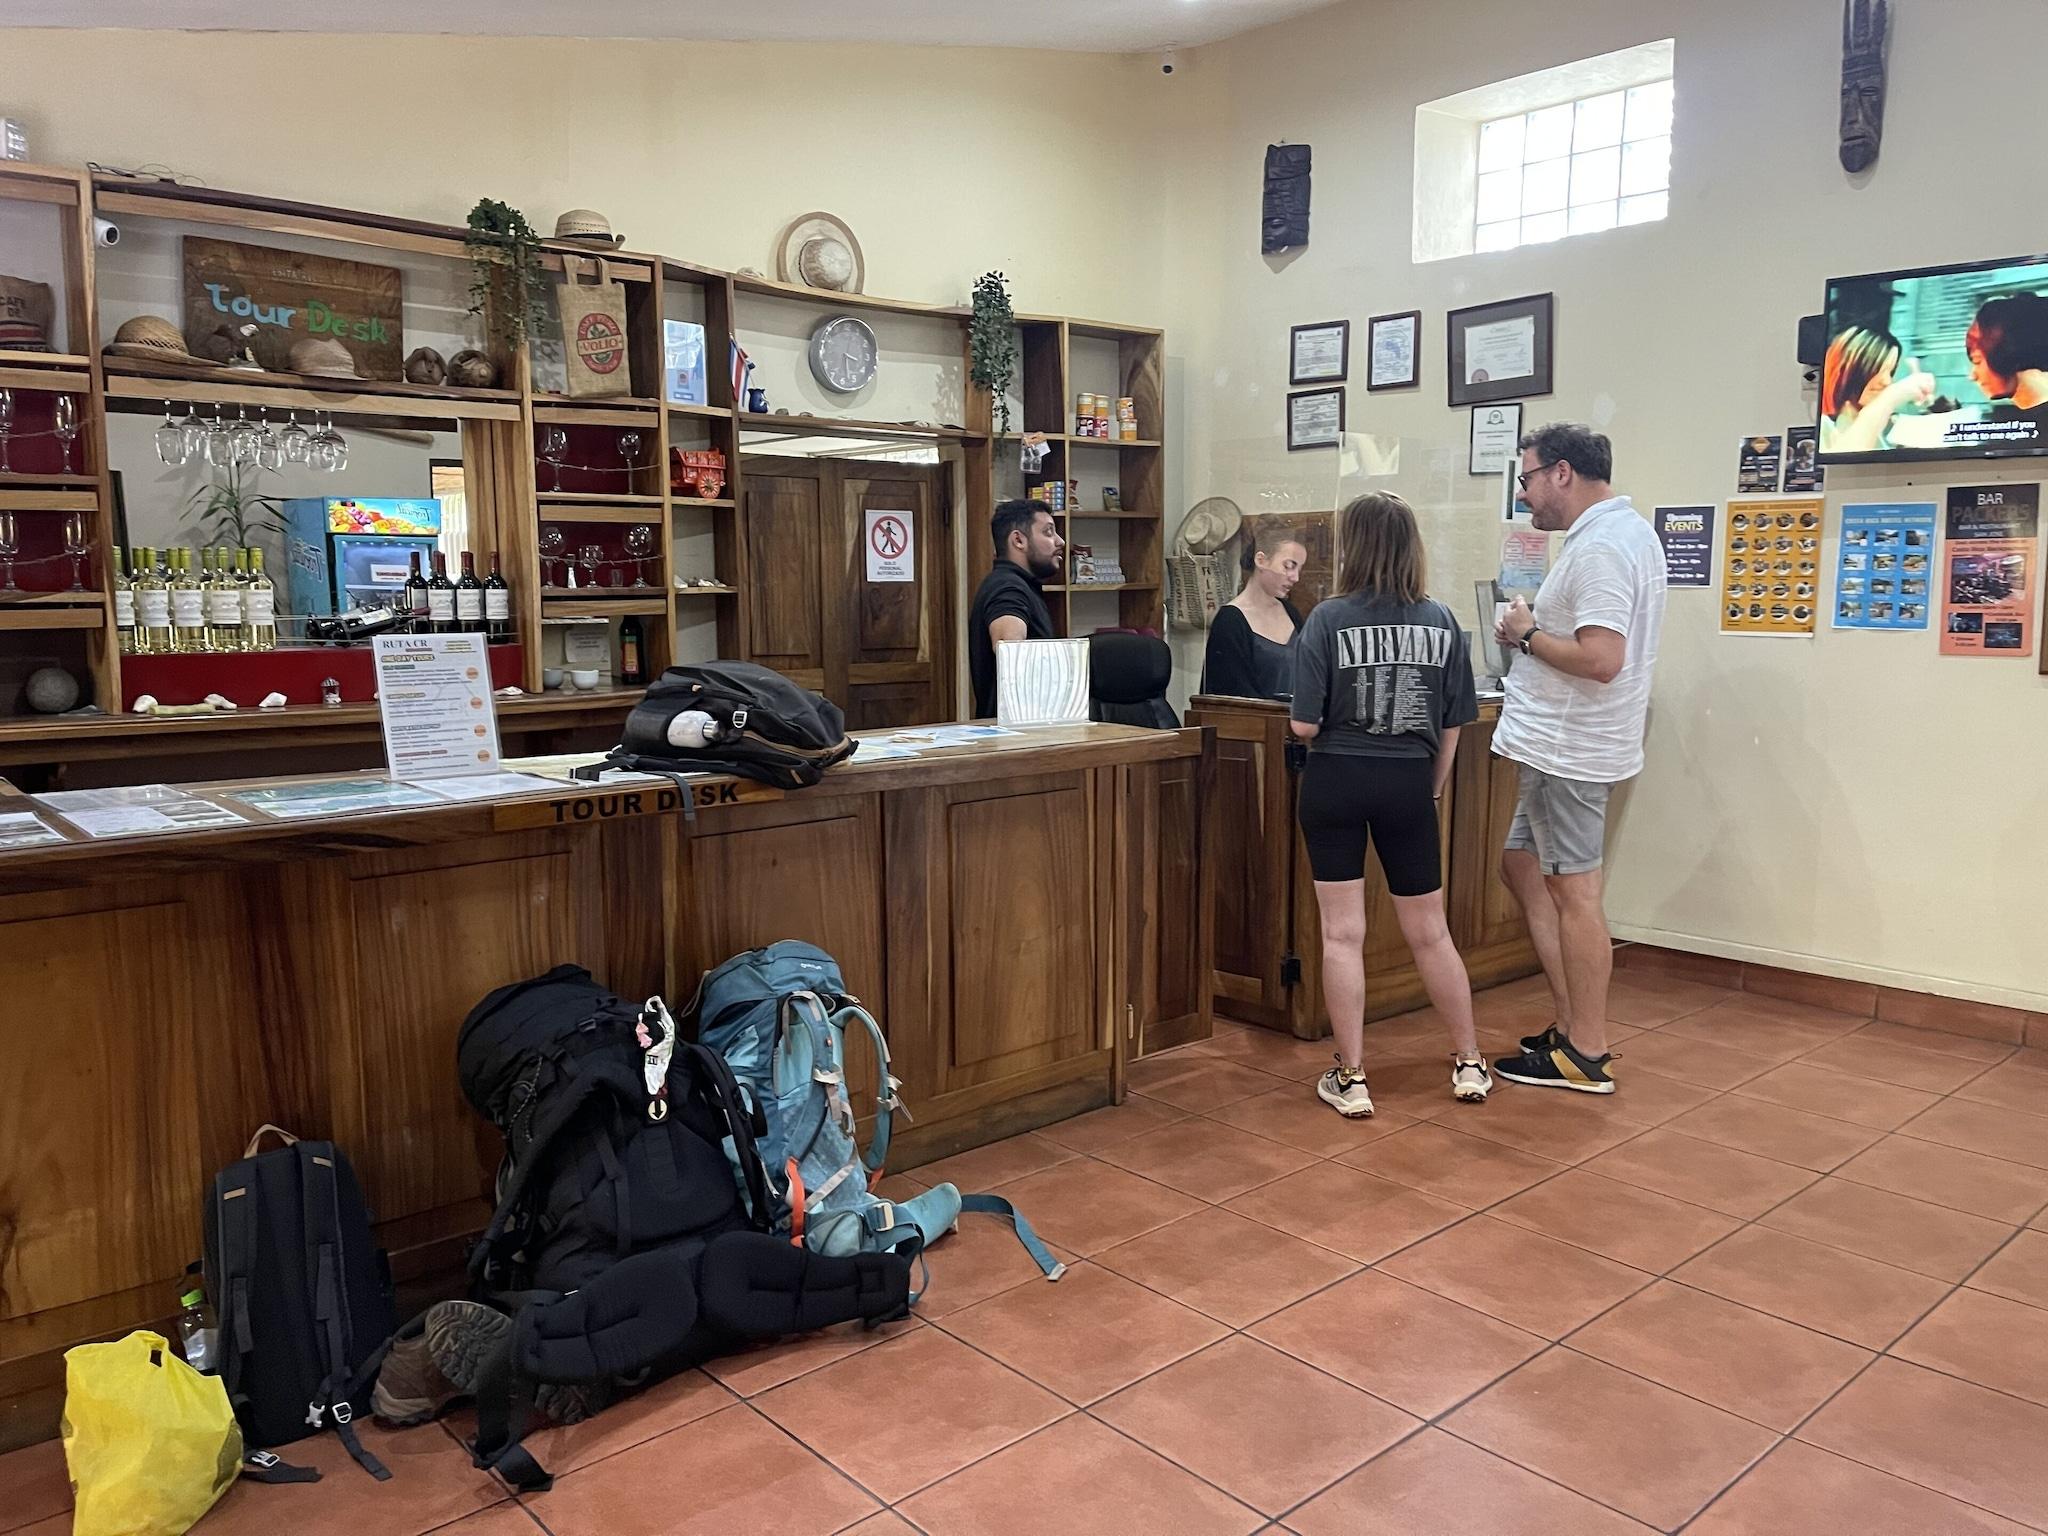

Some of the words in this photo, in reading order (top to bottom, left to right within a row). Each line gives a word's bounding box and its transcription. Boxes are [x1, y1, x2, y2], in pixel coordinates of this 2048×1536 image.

[307, 300, 388, 344] Desk
[583, 338, 618, 351] VOLIO
[1977, 493, 2004, 505] BAR
[1951, 504, 2031, 523] PACKERS
[1664, 521, 1704, 532] EVENTS
[1202, 567, 1217, 610] RICA
[382, 640, 412, 649] RUTA
[413, 639, 428, 648] CR
[550, 792, 642, 822] TOUR
